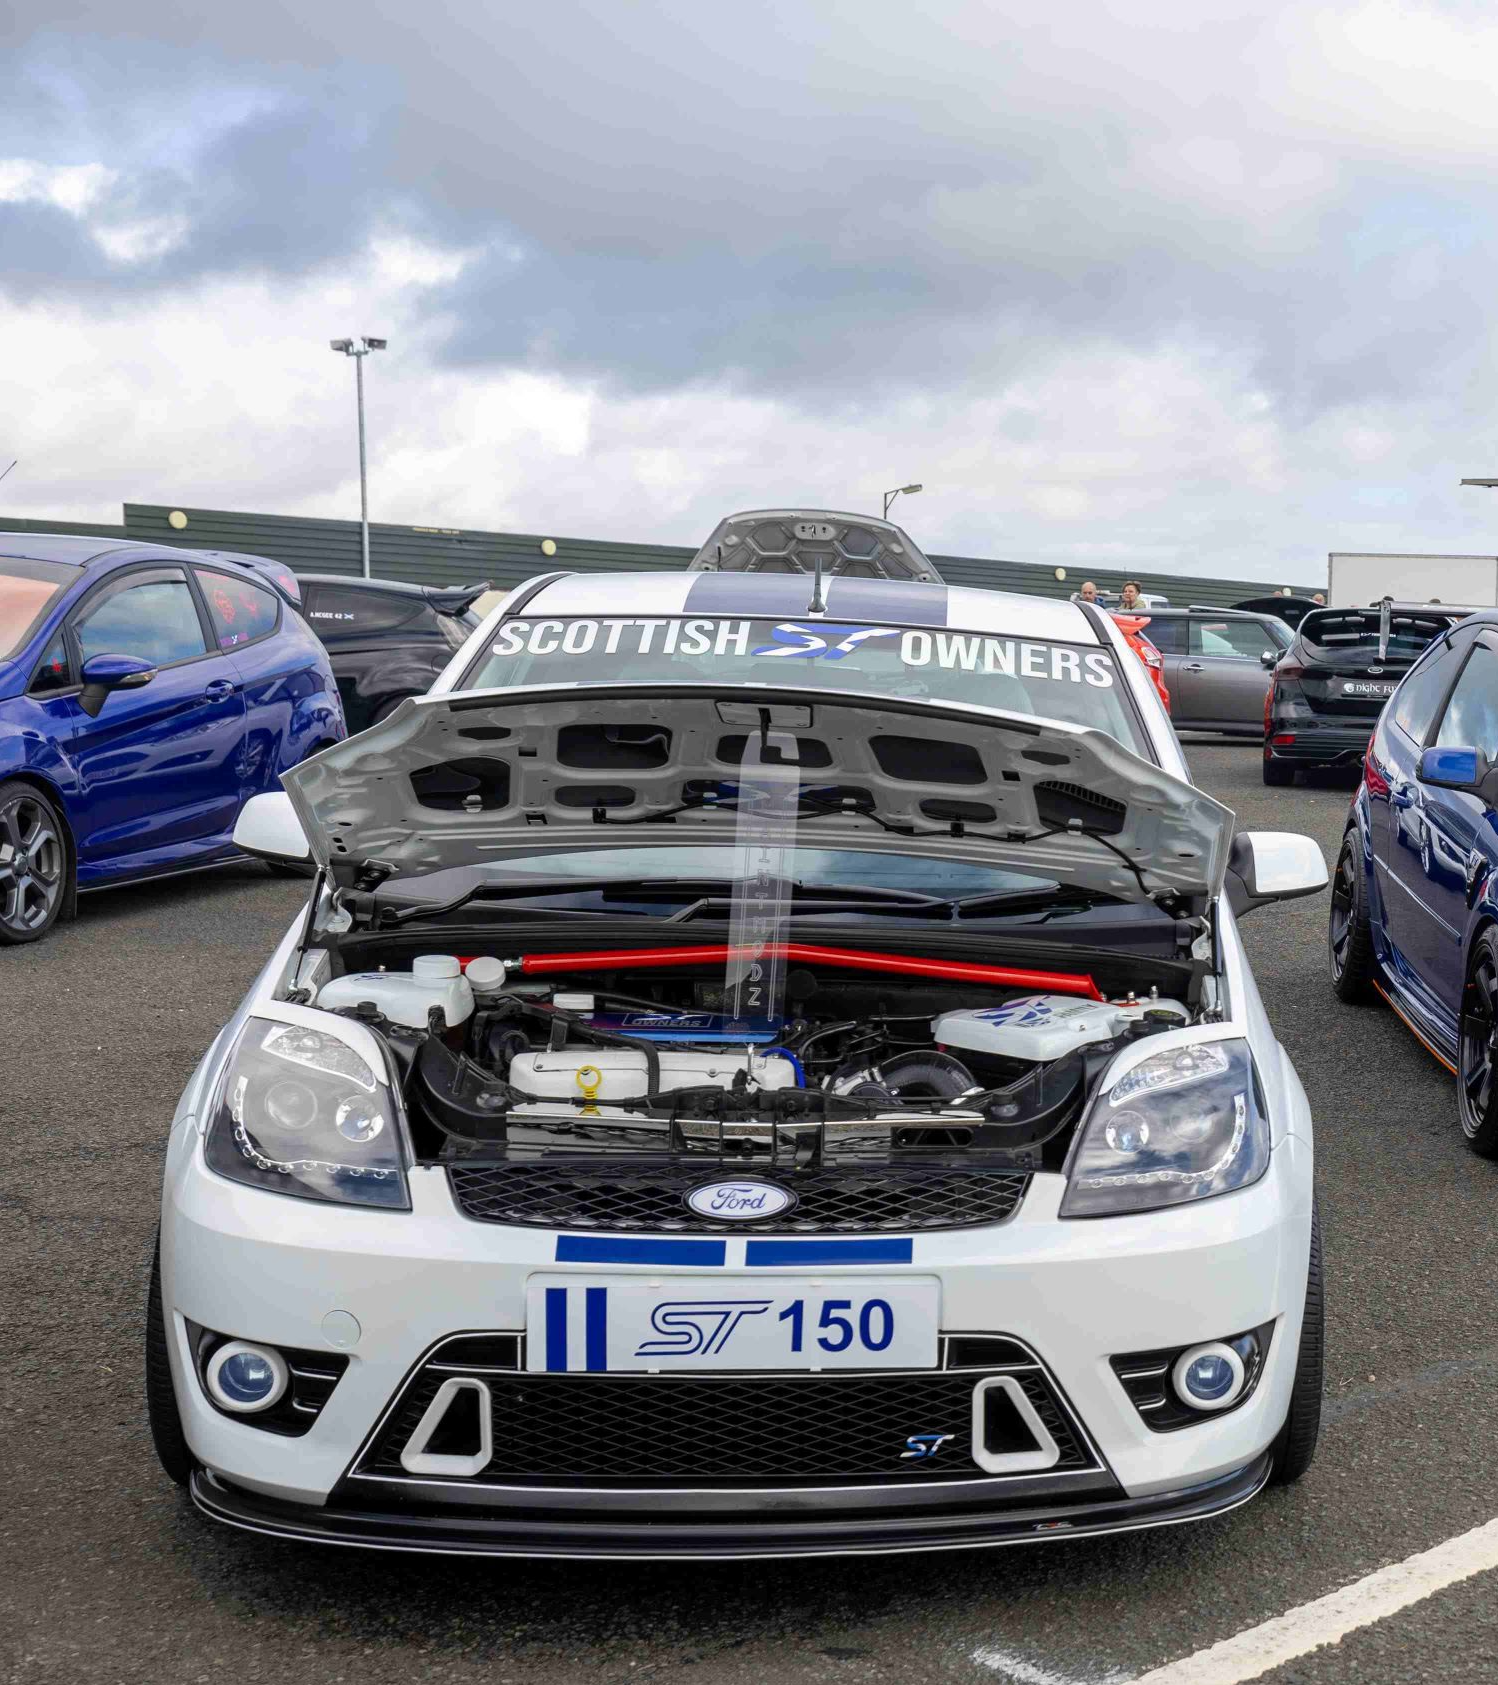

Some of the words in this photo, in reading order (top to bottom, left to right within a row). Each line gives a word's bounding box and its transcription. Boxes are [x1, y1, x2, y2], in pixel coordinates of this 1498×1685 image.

[492, 619, 751, 656] SCOTTISH
[900, 630, 1113, 689] OWNERS
[631, 1019, 702, 1027] OWNERS
[710, 1187, 767, 1211] Ford
[634, 1299, 775, 1357] ST
[777, 1298, 895, 1354] 150
[899, 1434, 956, 1458] ST
